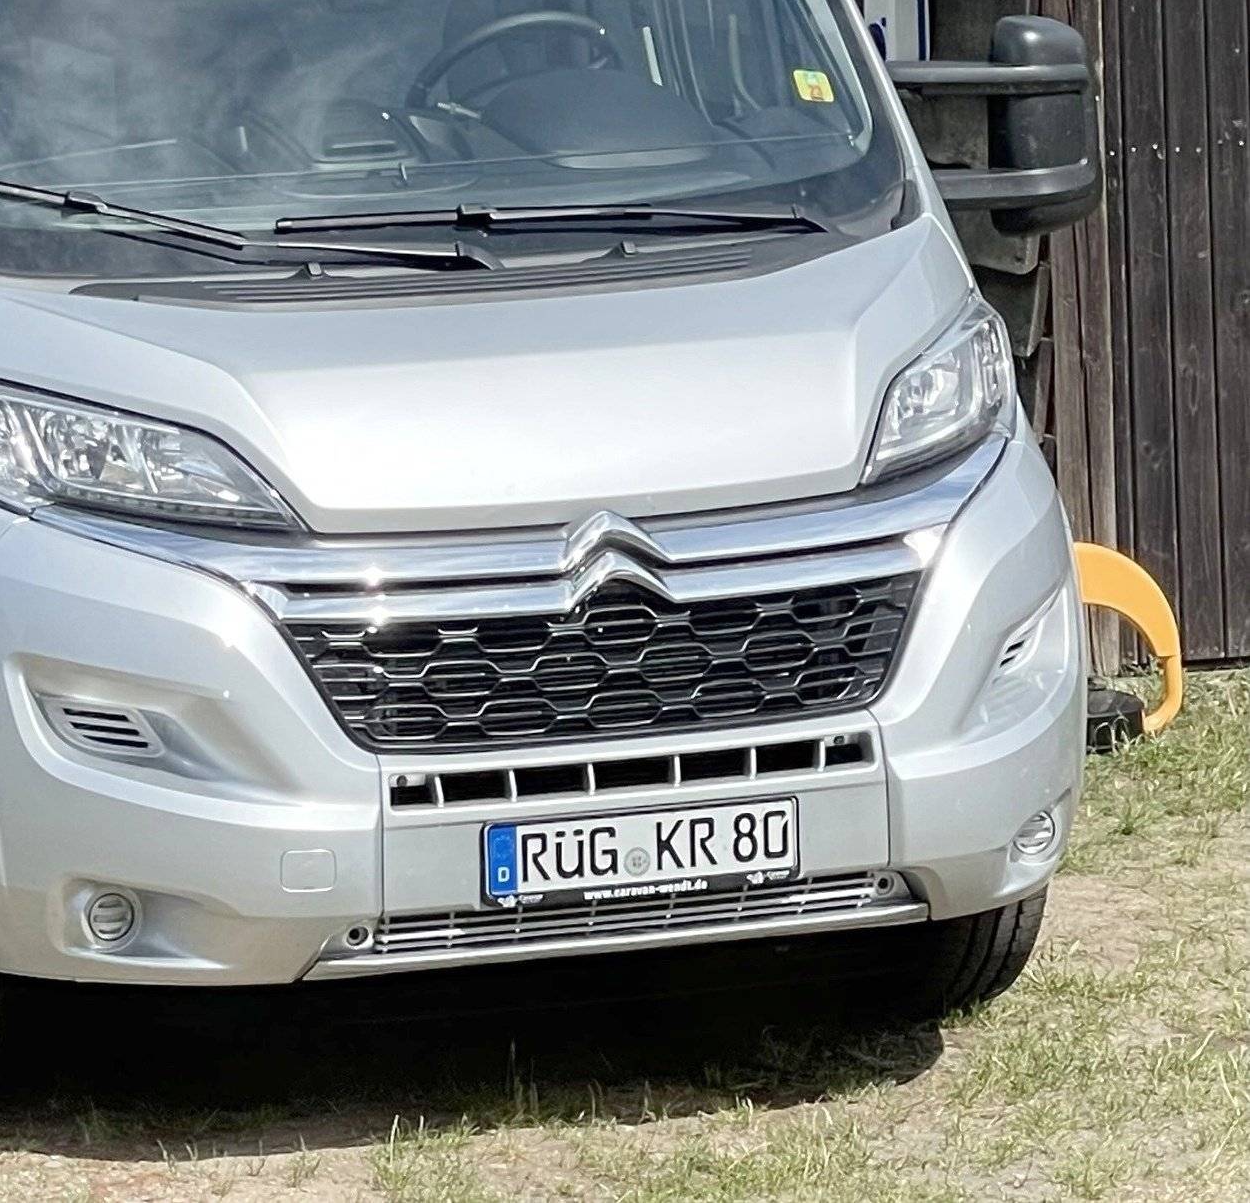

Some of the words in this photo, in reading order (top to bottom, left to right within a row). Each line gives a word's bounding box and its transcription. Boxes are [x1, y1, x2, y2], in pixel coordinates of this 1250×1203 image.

[655, 817, 718, 871] KR
[732, 809, 789, 863] 80
[498, 866, 510, 883] D
